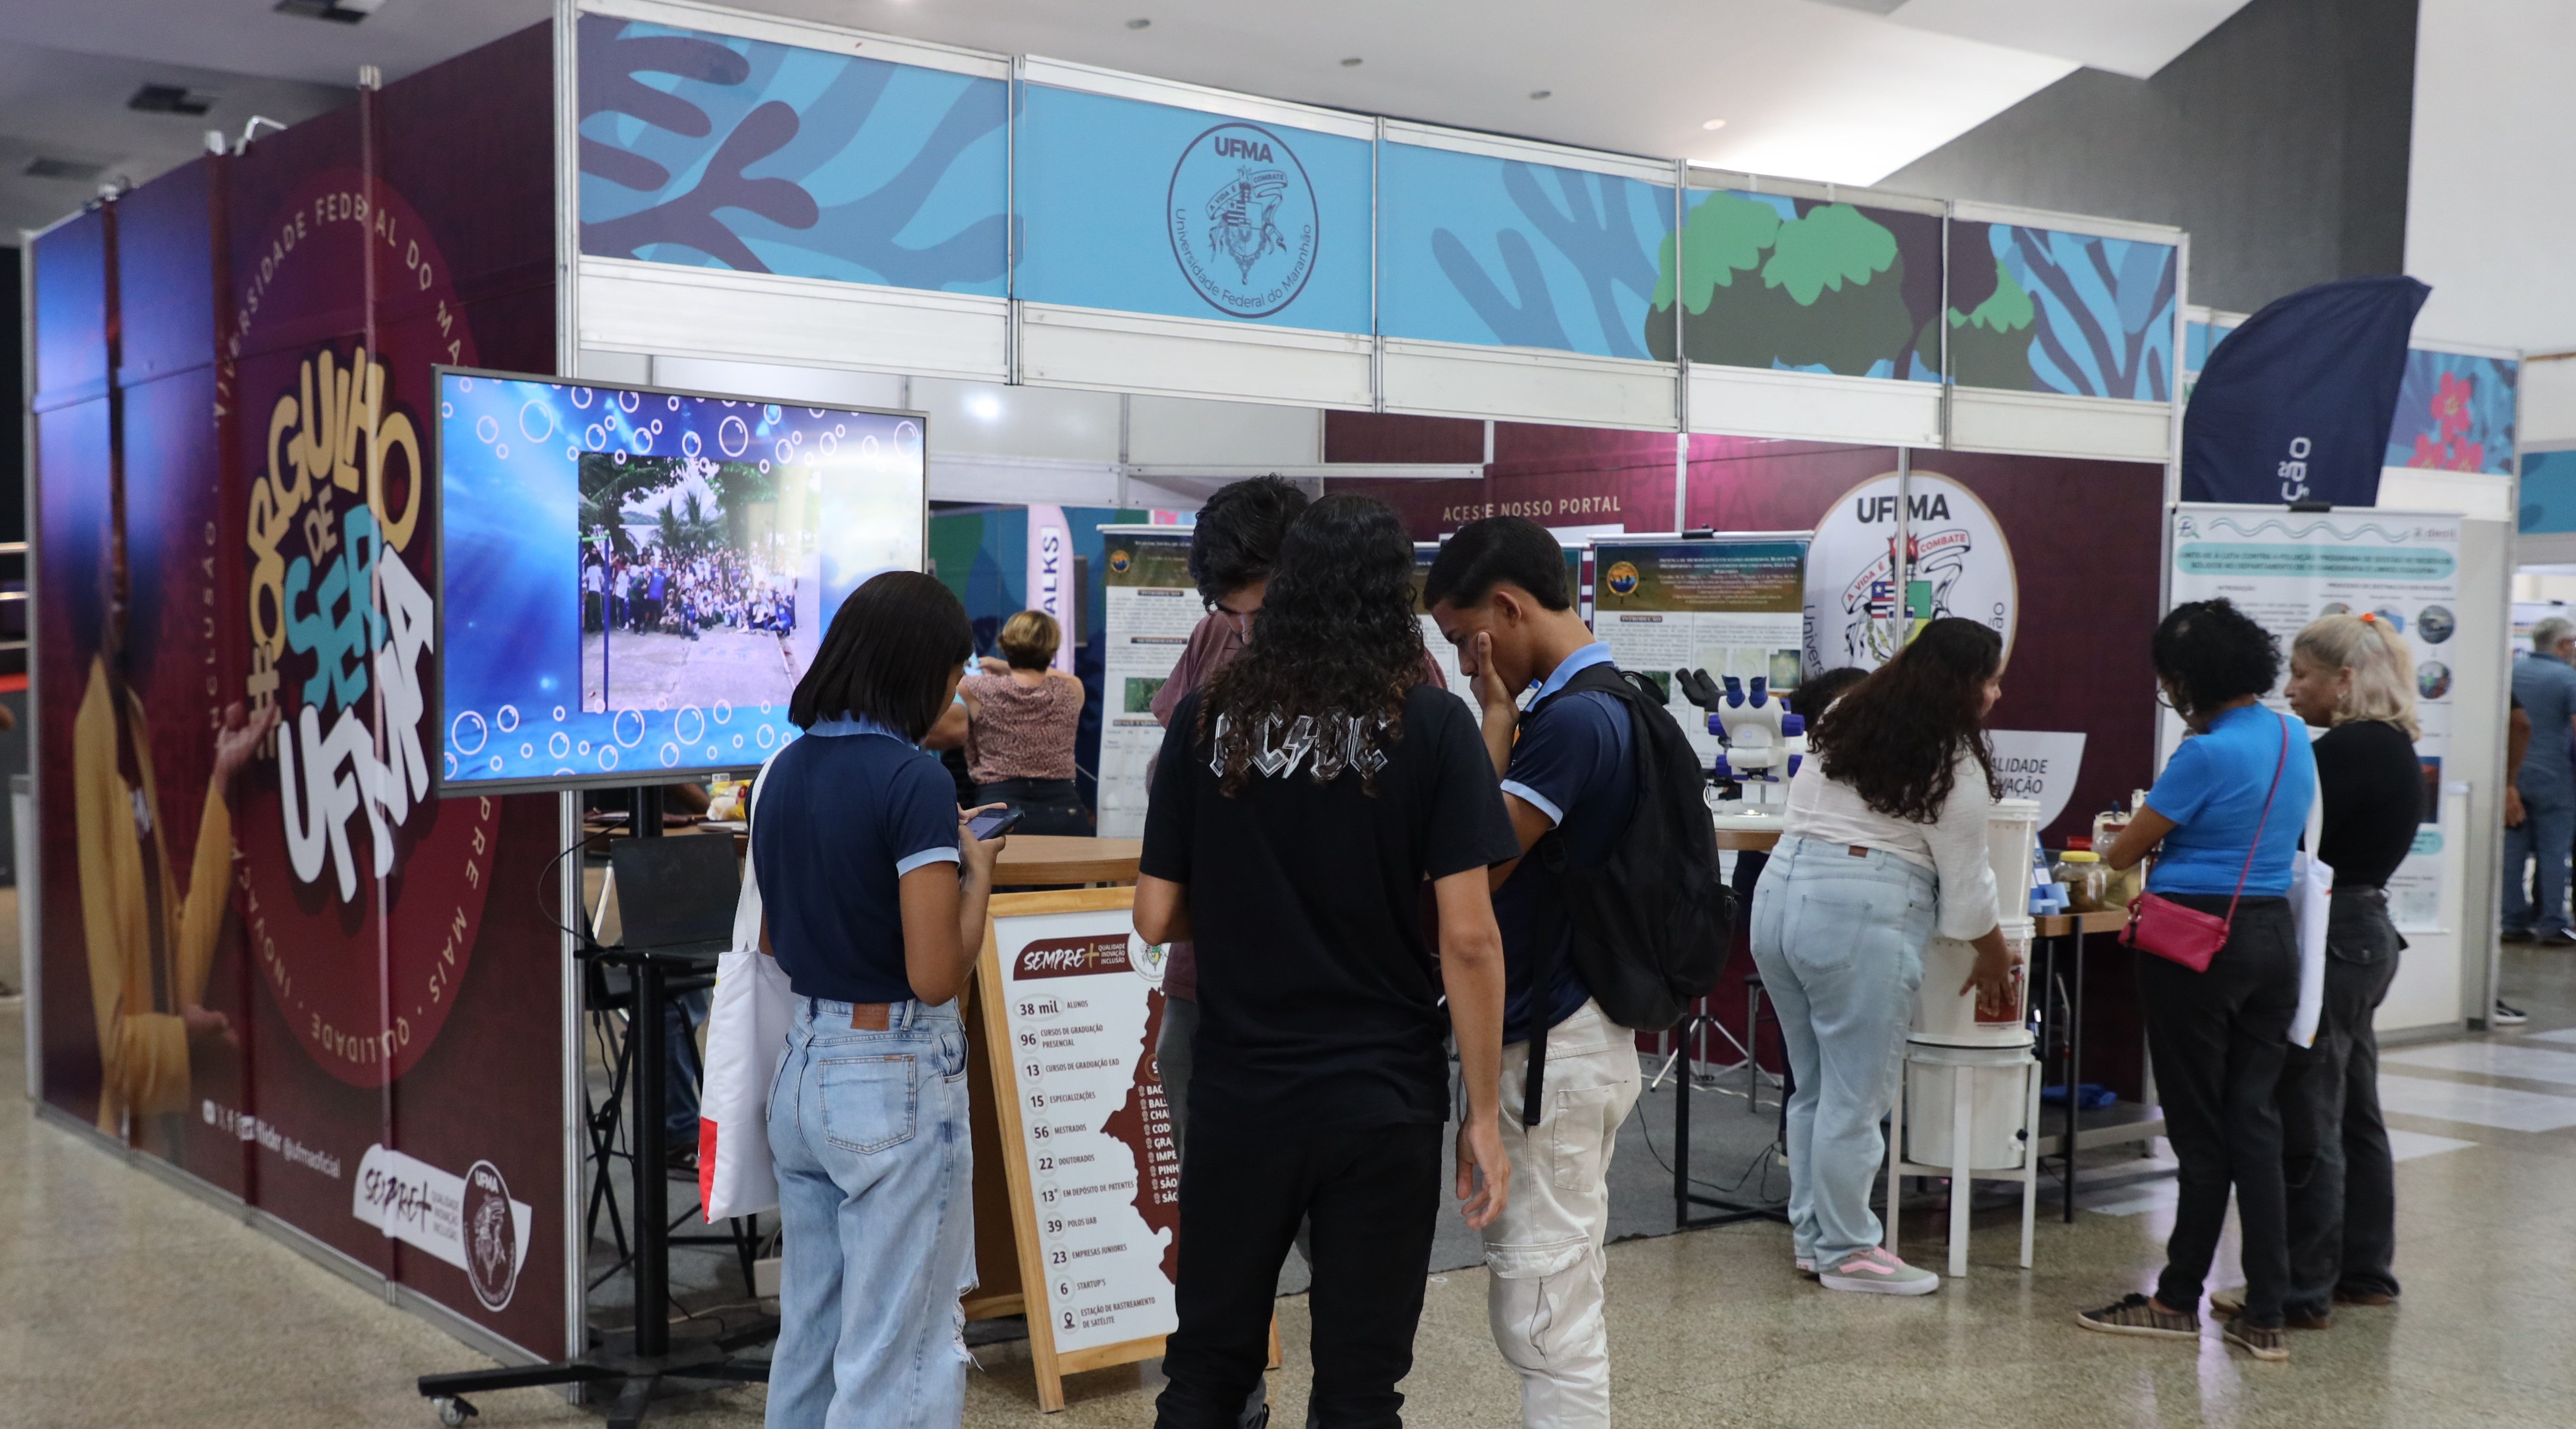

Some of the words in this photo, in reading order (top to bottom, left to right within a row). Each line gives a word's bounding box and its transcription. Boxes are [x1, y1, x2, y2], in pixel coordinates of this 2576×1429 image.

[1214, 136, 1273, 163] UFMA
[1253, 174, 1284, 183] COMBATE
[406, 239, 432, 291] DO
[1176, 208, 1220, 296] Universidade
[1222, 290, 1266, 308] Federal
[1267, 288, 1283, 303] do
[1282, 224, 1311, 292] Maranhão
[1501, 500, 1552, 517] NOSSO
[1559, 495, 1621, 514] PORTAL
[1857, 494, 1951, 524] UFMA
[304, 484, 338, 566] DE
[1847, 593, 1854, 602] A
[1854, 571, 1876, 591] VIDA
[1877, 561, 1885, 572] É
[1920, 533, 1966, 553] COMBATE
[284, 503, 387, 712] SER
[278, 543, 433, 904] UFMA
[429, 907, 467, 1004] MAIS
[1098, 943, 1125, 952] QUALIDADE
[1020, 1004, 1035, 1015] 38
[1038, 1000, 1059, 1014] mil
[1067, 1000, 1088, 1009] ALUNOS
[311, 1012, 409, 1064] QULIDADE
[1020, 1034, 1036, 1046] 96
[1071, 1024, 1103, 1034] GRADUAÇÃO
[1042, 1039, 1075, 1049] PRESENCIAL
[1026, 1064, 1040, 1077] 13
[1046, 1064, 1066, 1072] CURSOS
[1076, 1058, 1108, 1069] GRADUAÇÃO
[1031, 1095, 1044, 1107] 15
[1050, 1091, 1095, 1103] ESPECIALIZAÇÕES
[1150, 1109, 1170, 1120] CHA
[1035, 1126, 1049, 1139] 56
[1054, 1124, 1087, 1134] MESTRADOS
[1152, 1123, 1170, 1134] COD
[1154, 1137, 1174, 1149] GRA
[1039, 1157, 1053, 1170] 22
[1058, 1154, 1095, 1166] DOUTORADOS
[1158, 1164, 1180, 1175] PINH
[475, 1169, 499, 1193] UFMA
[1072, 1186, 1099, 1196] DEPÓSITO
[1109, 1181, 1134, 1191] PATENTES
[1160, 1176, 1177, 1189] SÃO
[1048, 1220, 1062, 1233] 39
[1067, 1219, 1085, 1228] POLOS
[1086, 1217, 1097, 1225] UAB
[1052, 1251, 1067, 1264] 23
[1072, 1248, 1101, 1259] EMPRESAS
[1101, 1243, 1127, 1254] JUNIORES
[1060, 1283, 1068, 1295] 6
[1077, 1279, 1106, 1290] STARTUP'S
[1080, 1304, 1104, 1317] ESTAÇÃO
[1105, 1304, 1112, 1312] DE
[1113, 1297, 1155, 1310] RASTREAMENTO
[1091, 1316, 1115, 1327] SATÉLITE
